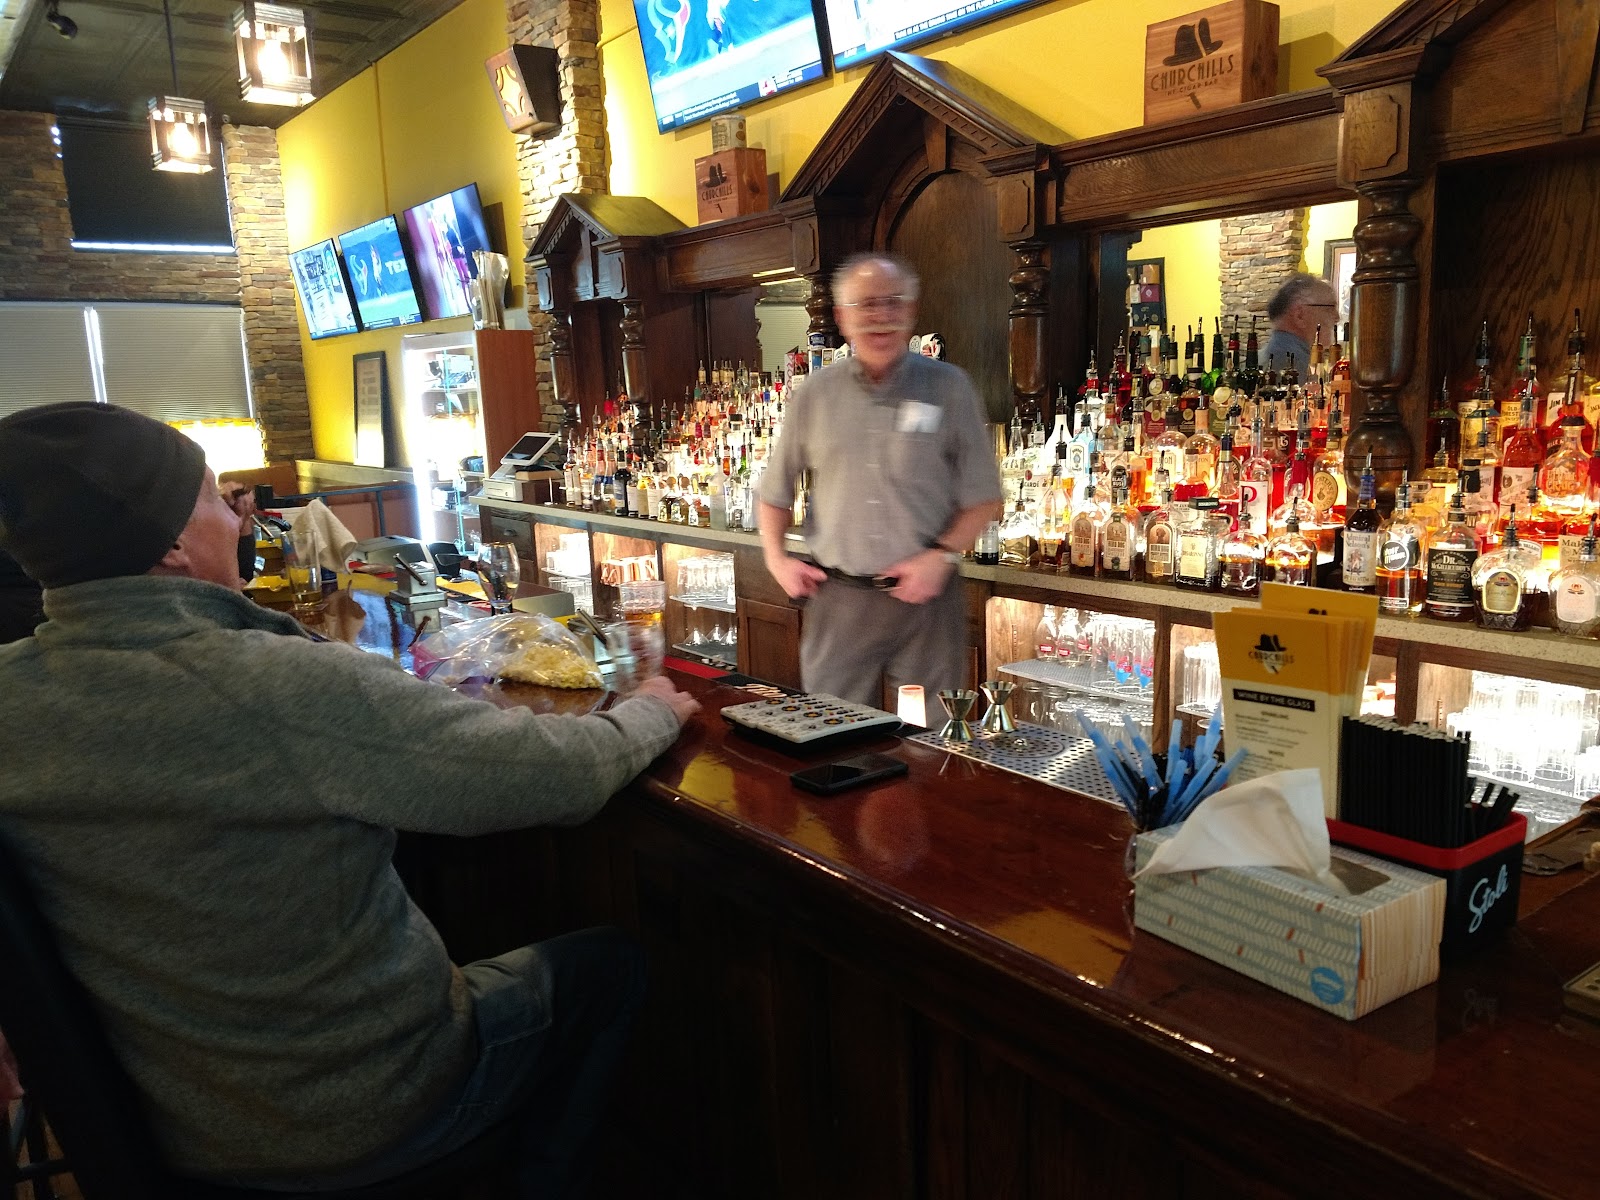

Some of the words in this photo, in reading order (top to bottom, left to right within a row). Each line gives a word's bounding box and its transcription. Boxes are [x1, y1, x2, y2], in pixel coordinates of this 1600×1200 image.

[1150, 54, 1234, 92] CHURCHILLS
[701, 184, 732, 201] CHURCHILLS
[1237, 691, 1257, 700] WINE
[1260, 694, 1270, 702] BY
[1270, 696, 1285, 704] THE
[1287, 699, 1311, 709] GLASS
